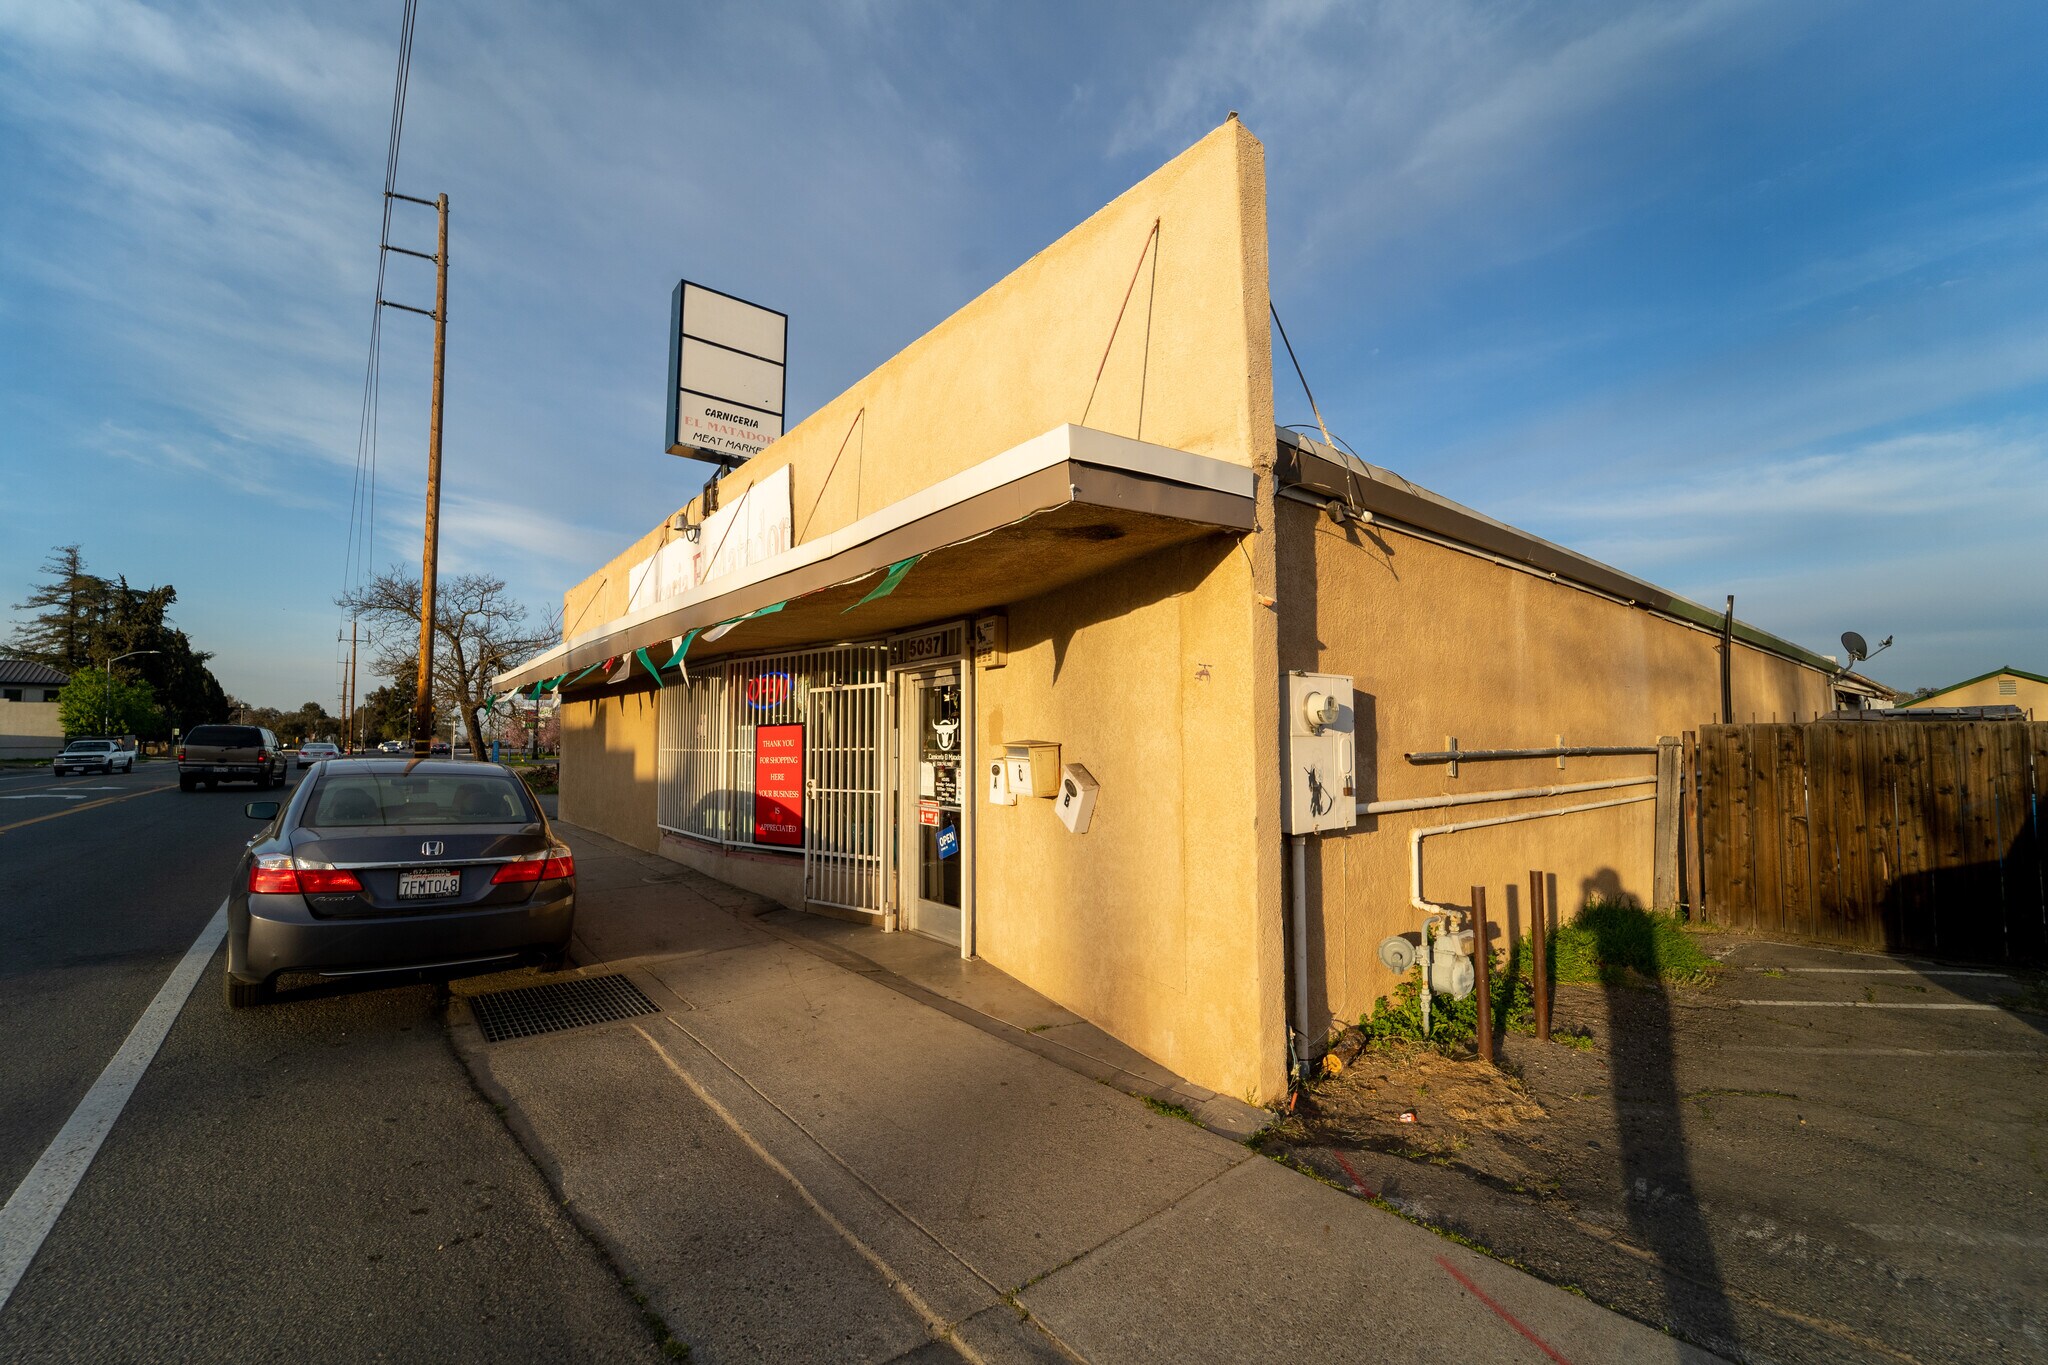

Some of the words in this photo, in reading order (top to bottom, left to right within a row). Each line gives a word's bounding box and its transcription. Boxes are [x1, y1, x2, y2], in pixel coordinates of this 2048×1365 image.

[705, 408, 759, 428] CARNICERIA
[685, 416, 702, 428] EL
[708, 421, 775, 444] MATADOR
[693, 432, 723, 446] MEAT
[725, 440, 764, 454] MARKE
[910, 636, 940, 657] 5037
[748, 677, 788, 703] OPEN
[782, 739, 794, 747] YOU
[770, 756, 798, 764] SHOPPING
[773, 790, 799, 798] BUSINESS
[760, 824, 797, 832] APPRECIATED
[939, 831, 955, 847] OPEN
[402, 879, 458, 896] 7FMT048
